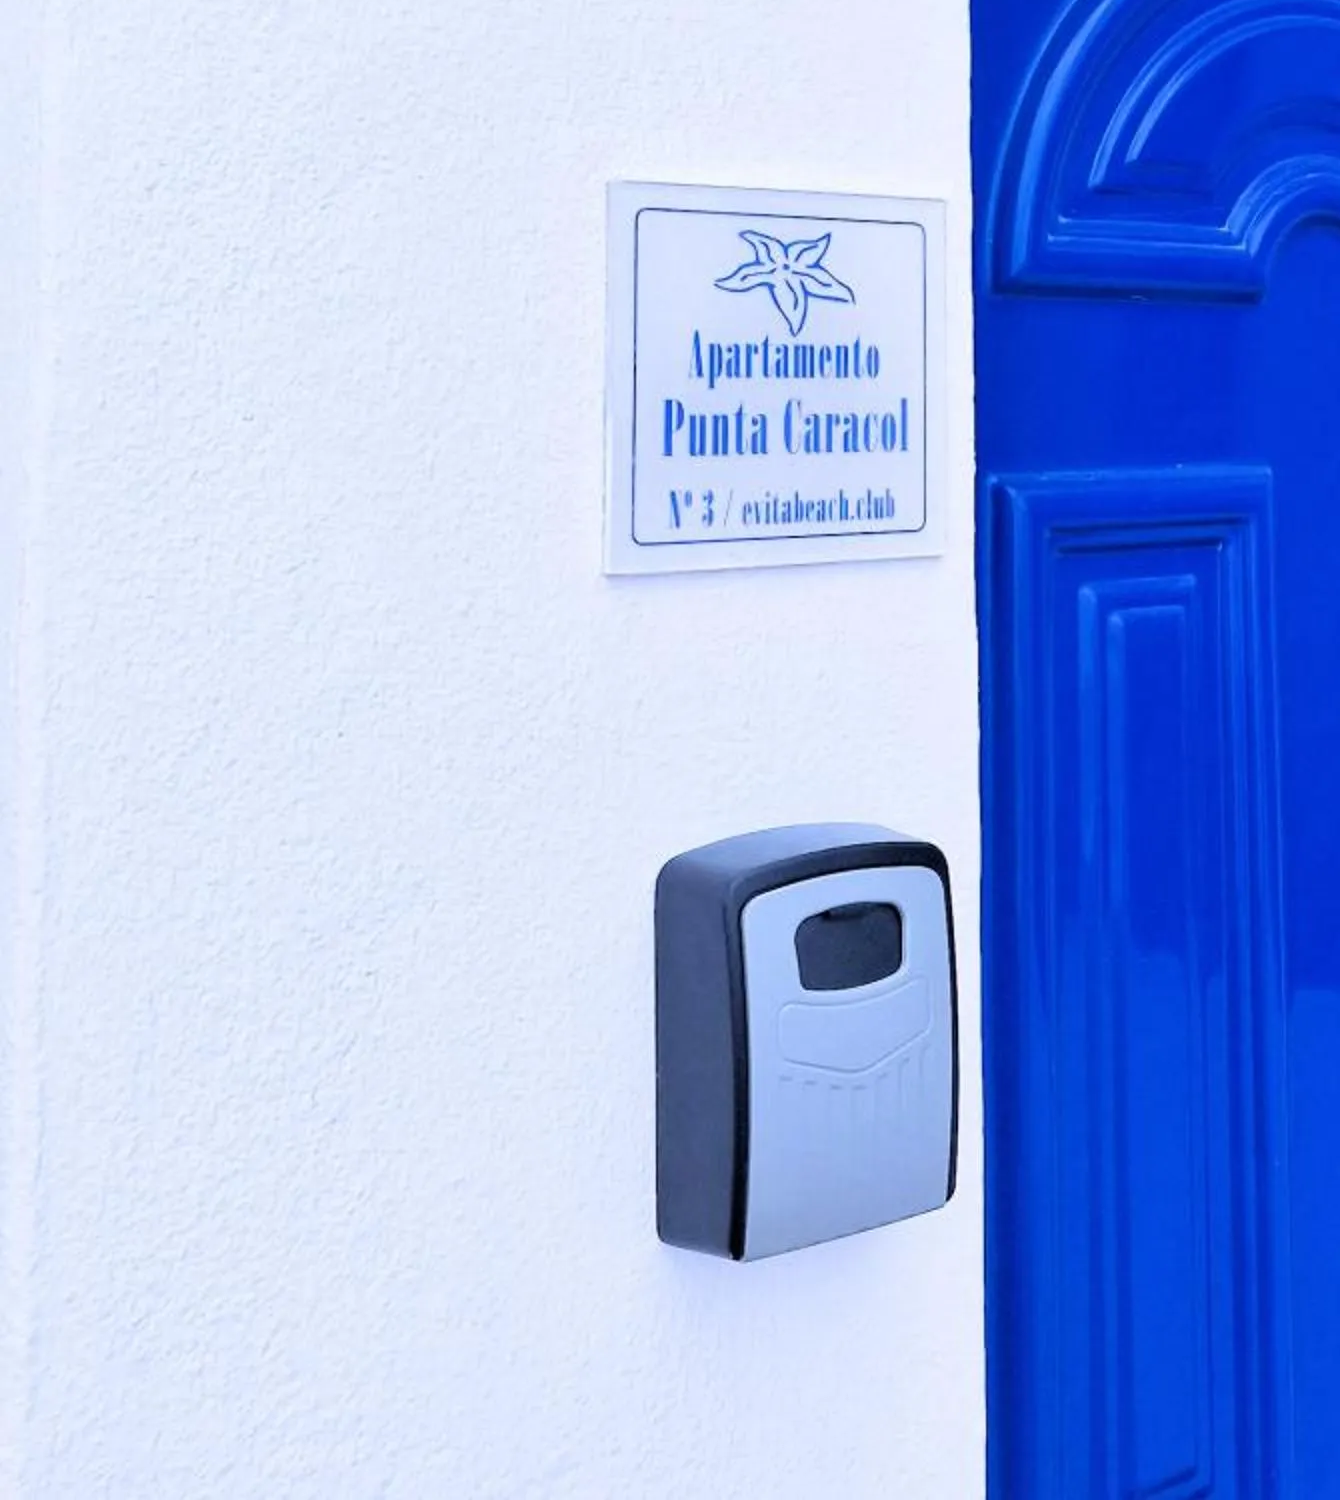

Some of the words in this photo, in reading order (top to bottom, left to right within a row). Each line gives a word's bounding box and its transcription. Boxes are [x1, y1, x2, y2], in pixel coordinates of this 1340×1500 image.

[687, 329, 881, 389] Apartamento
[662, 398, 769, 457] Punta
[783, 397, 909, 454] Caracol
[701, 489, 715, 527] 3
[741, 488, 896, 527] evitabeach.club
